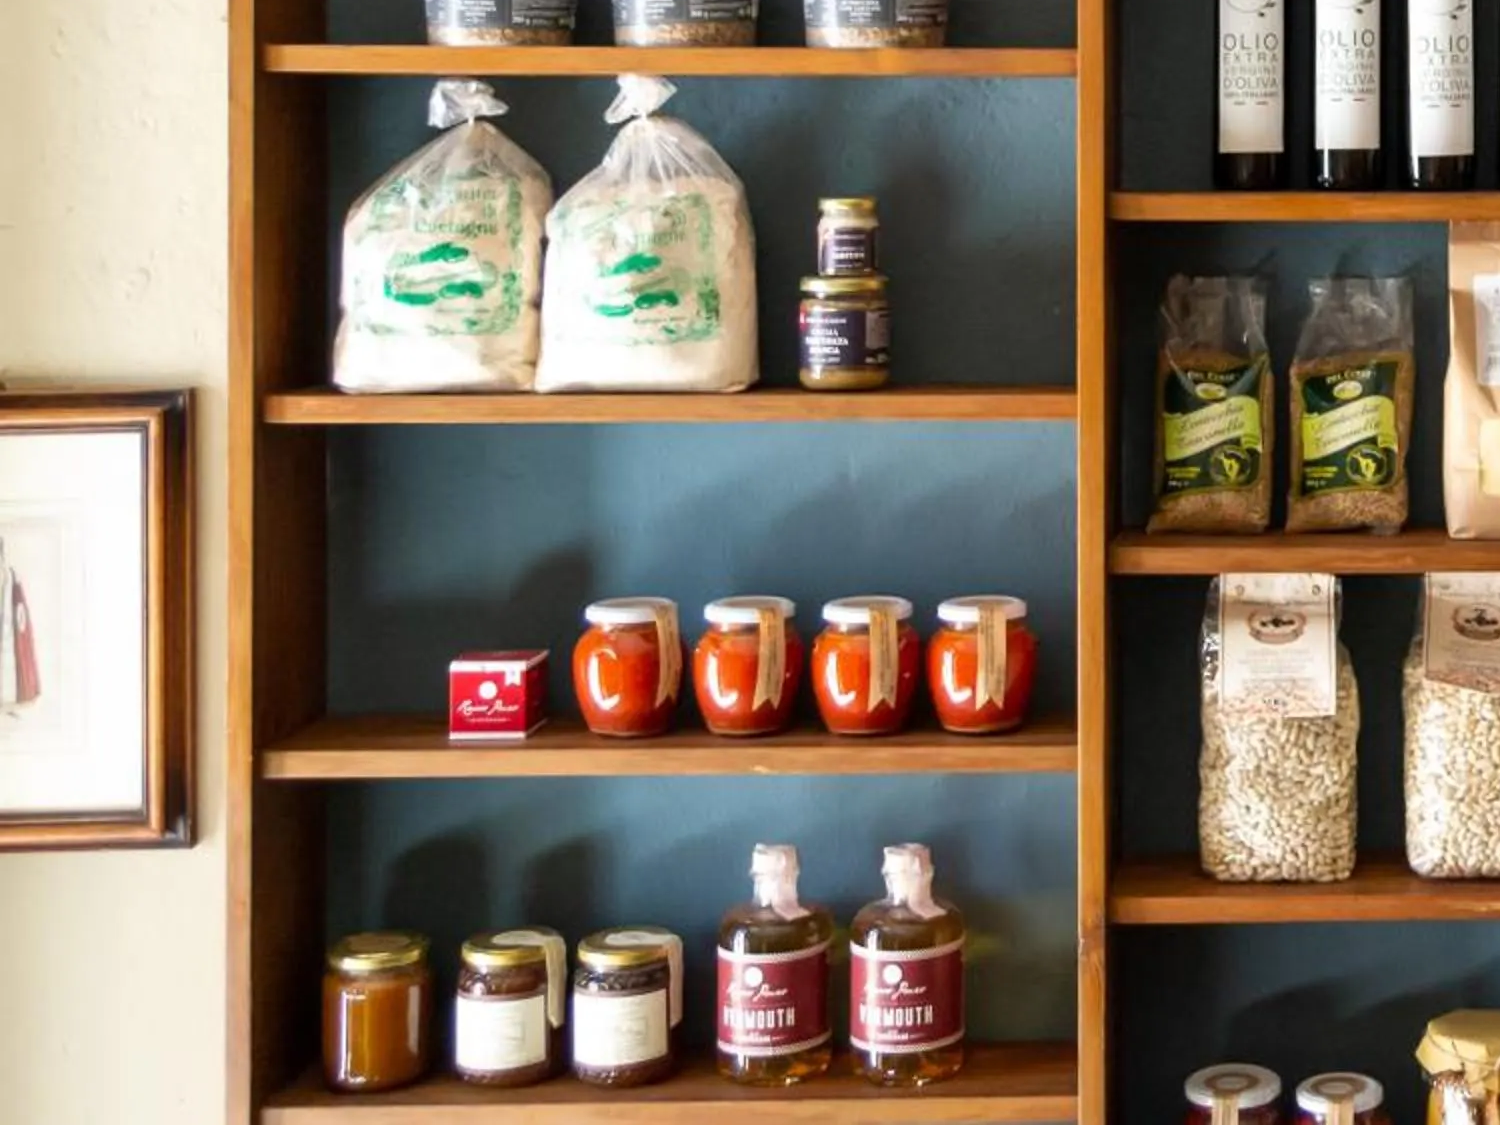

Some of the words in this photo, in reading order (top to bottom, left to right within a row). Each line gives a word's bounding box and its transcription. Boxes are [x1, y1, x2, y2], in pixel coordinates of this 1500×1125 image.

[1222, 32, 1279, 52] OLIO
[1319, 28, 1376, 49] OLIO
[1416, 34, 1470, 54] OLIO
[1222, 52, 1279, 66] EXTRA
[1424, 54, 1470, 66] XTRA
[723, 1004, 796, 1029] VRMOUTH
[859, 1002, 934, 1027] VRMOUTH
